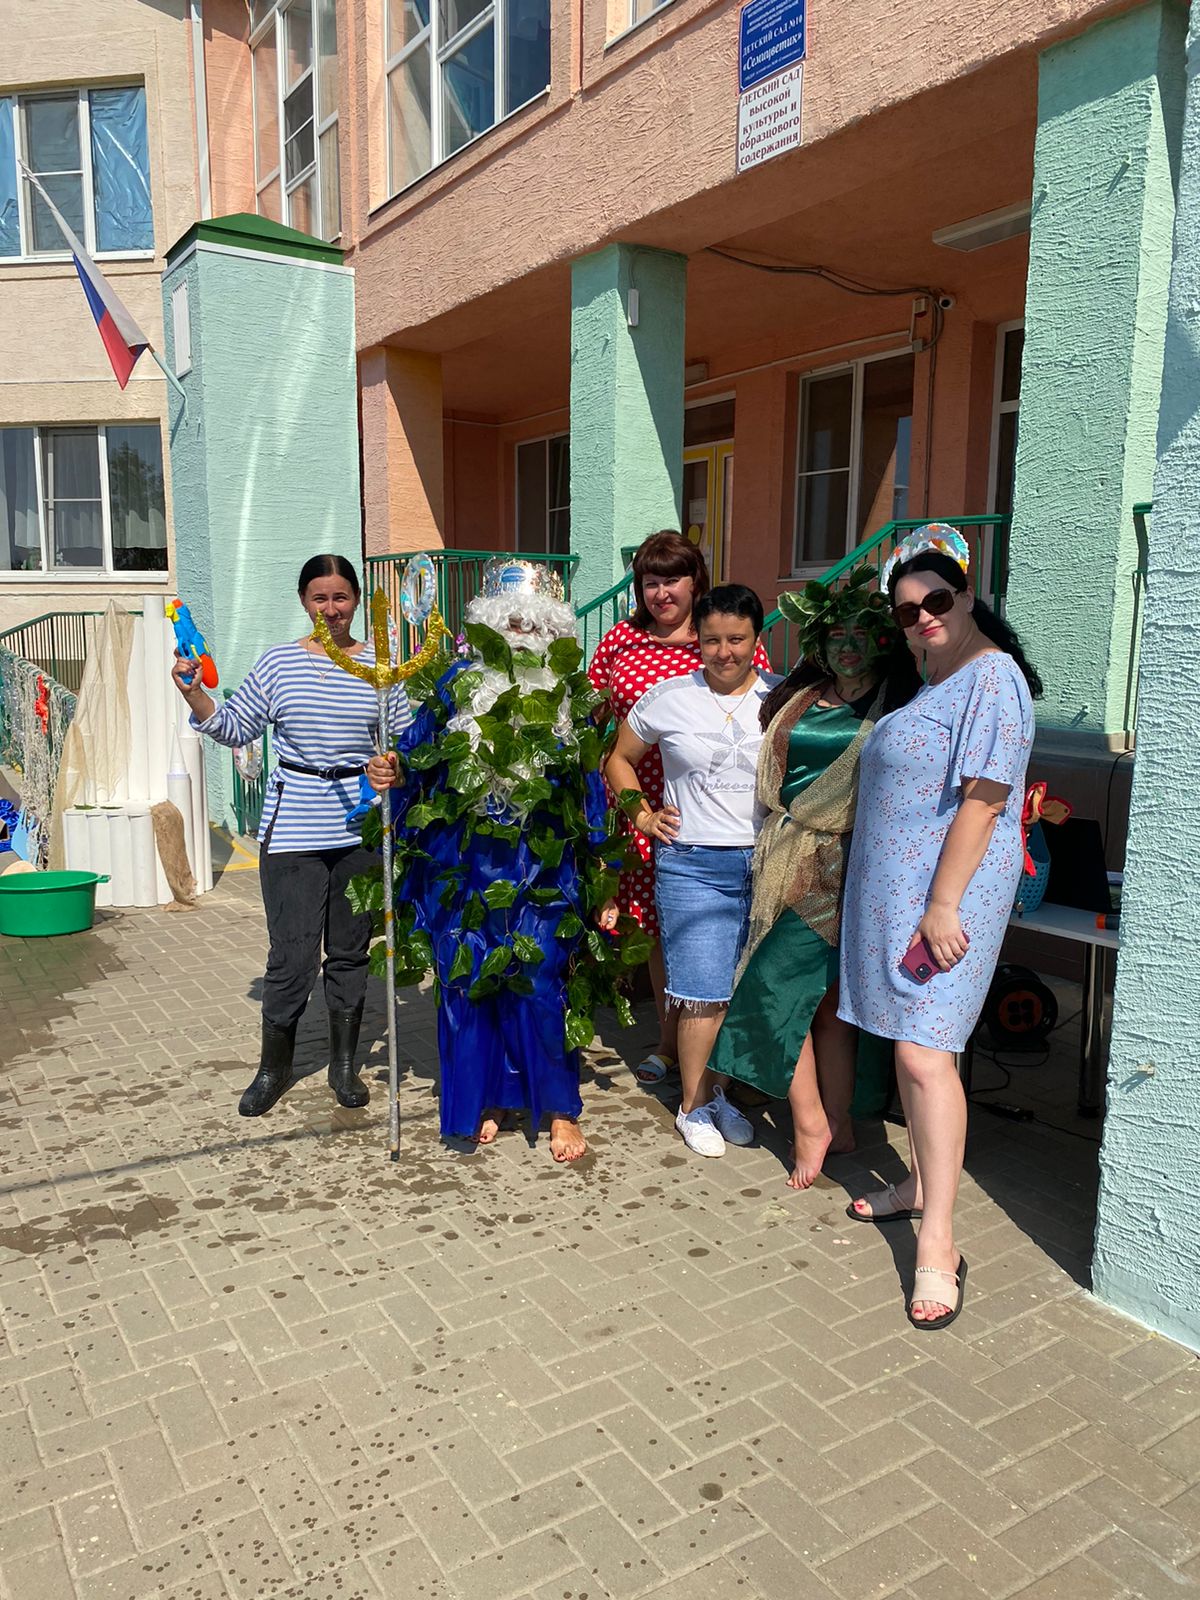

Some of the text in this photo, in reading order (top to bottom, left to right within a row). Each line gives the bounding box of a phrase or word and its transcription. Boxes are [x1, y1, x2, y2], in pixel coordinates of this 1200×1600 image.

[743, 30, 773, 57] ДЕТСКИЙ
[774, 22, 788, 37] САД
[742, 68, 800, 107] ДЕТСКИЙ САД
[749, 87, 791, 117] высокой
[740, 116, 800, 151] образцового
[743, 106, 788, 140] культуры
[740, 131, 799, 165] содержания
